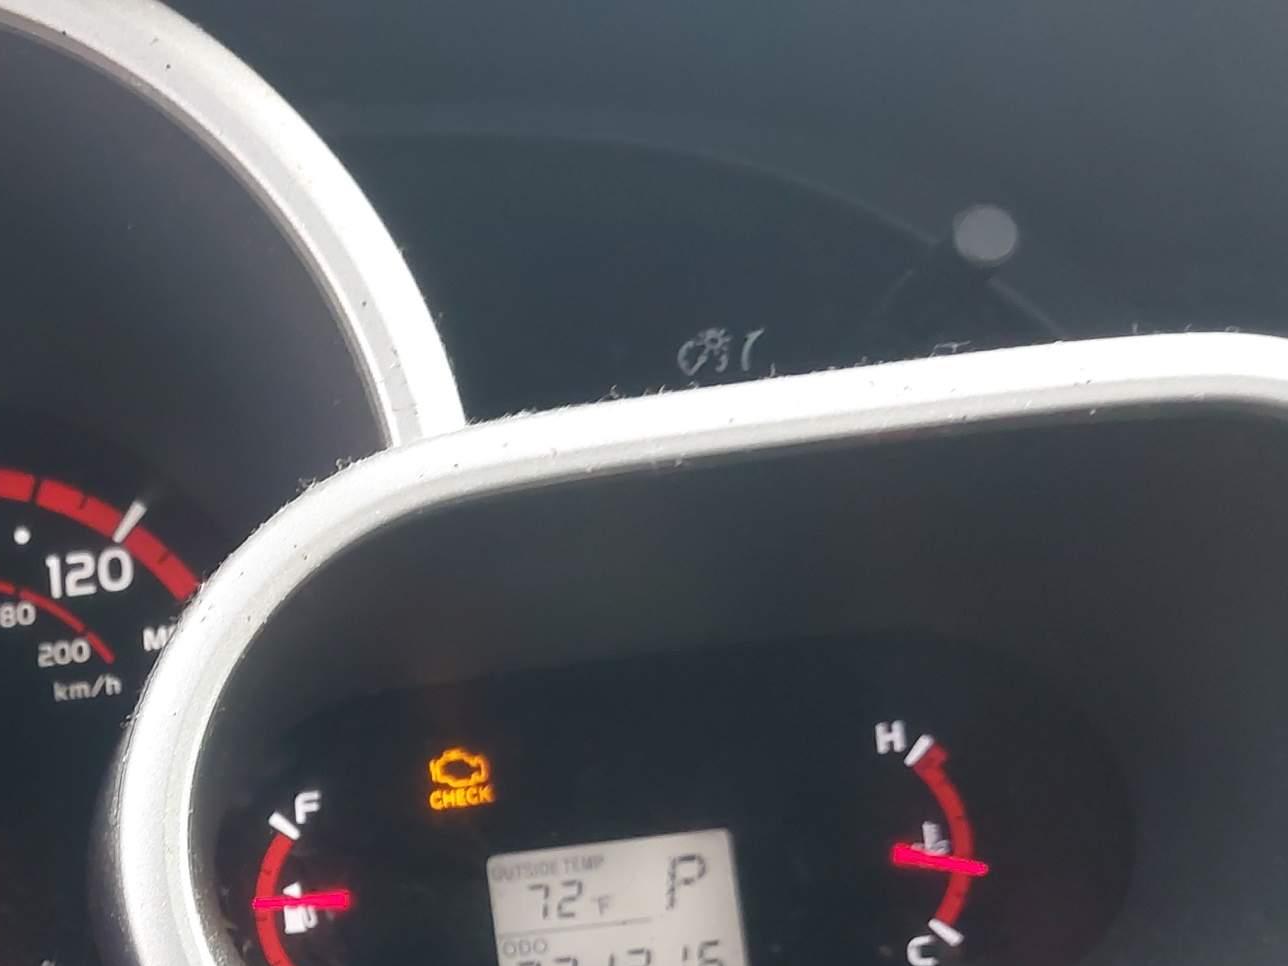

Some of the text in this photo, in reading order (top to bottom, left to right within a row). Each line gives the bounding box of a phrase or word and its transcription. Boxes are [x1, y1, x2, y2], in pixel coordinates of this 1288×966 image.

[45, 546, 134, 599] 120
[37, 638, 91, 668] 200
[53, 673, 121, 703] km/h
[875, 719, 907, 754] H
[295, 790, 322, 825] F
[429, 785, 494, 810] CHECK
[562, 853, 605, 876] TEMP
[666, 853, 708, 911] P
[528, 879, 584, 920] 72
[501, 937, 548, 959] ODO
